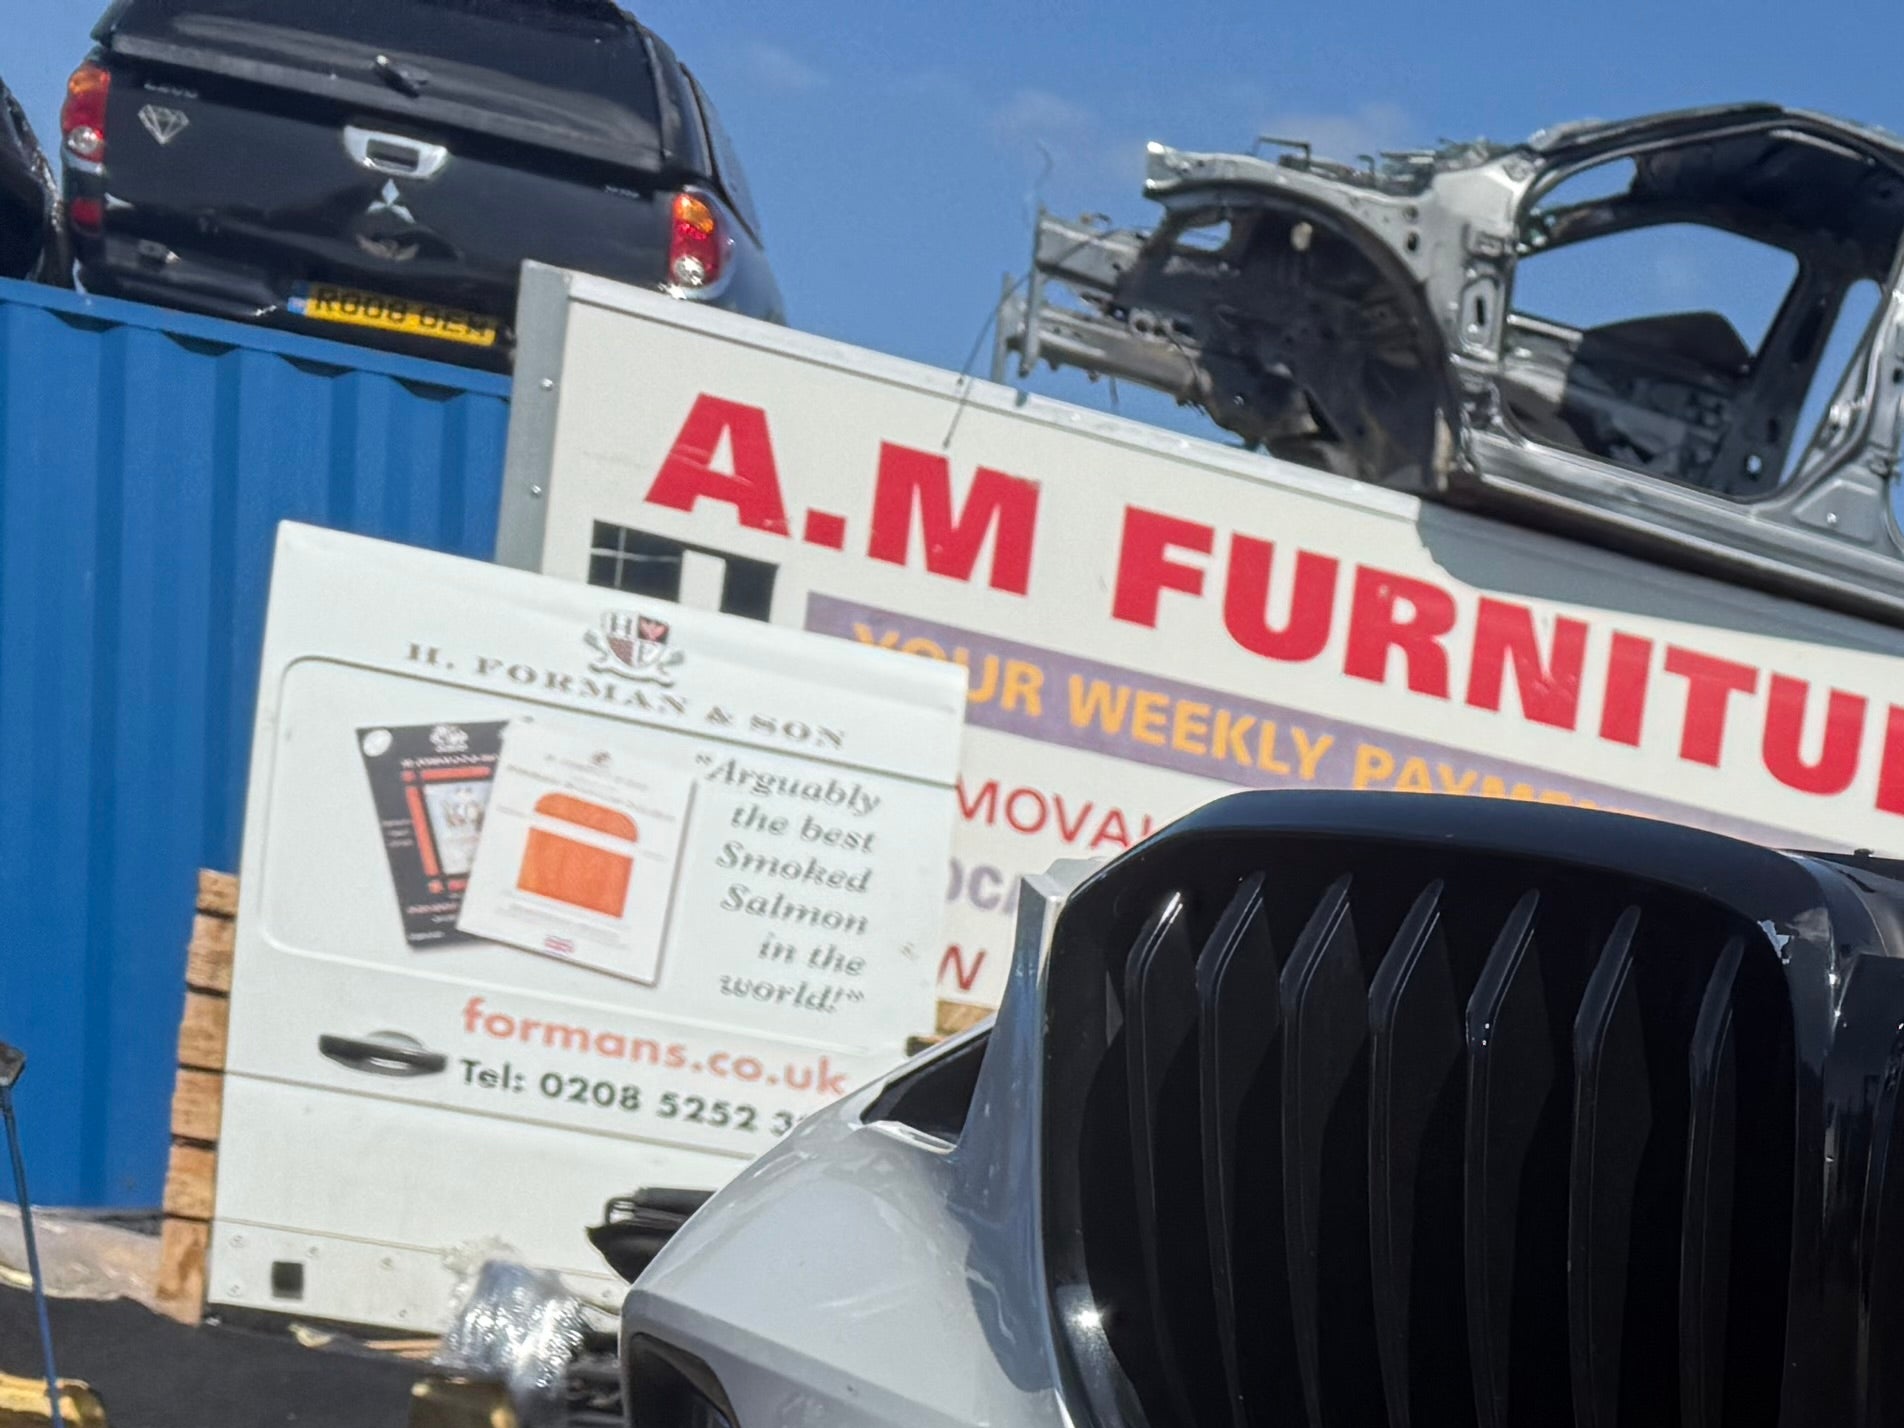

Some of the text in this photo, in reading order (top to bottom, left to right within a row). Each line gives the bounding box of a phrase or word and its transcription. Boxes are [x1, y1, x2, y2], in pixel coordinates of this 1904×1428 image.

[644, 392, 1042, 597] A.M
[405, 642, 845, 750] H. FORMAN & SON
[1068, 673, 1334, 780] WEEKLY
[715, 839, 874, 893] Smoked
[730, 803, 877, 854] the best
[719, 882, 869, 935] Salmon
[757, 931, 866, 977] in the
[461, 995, 847, 1098] formans.co.uk
[461, 1058, 525, 1094] Tel:
[539, 1071, 642, 1113] 0208
[656, 1090, 759, 1133] 5252
